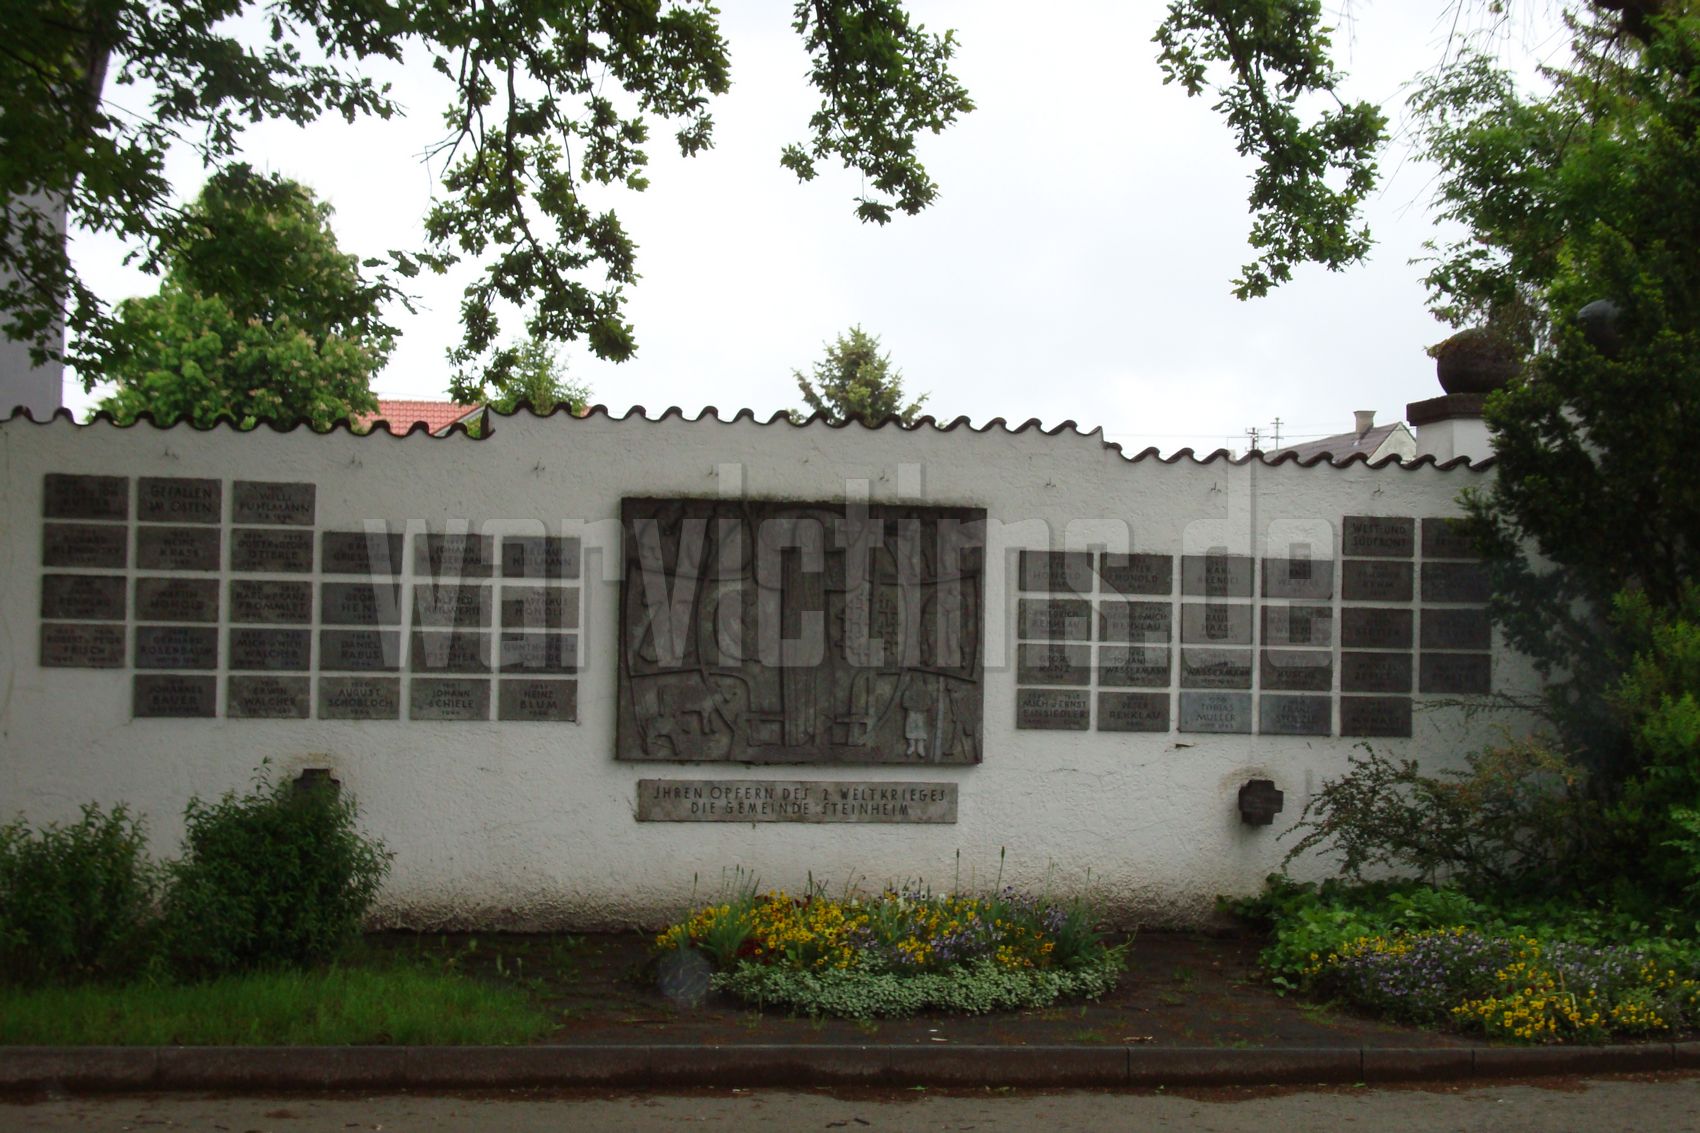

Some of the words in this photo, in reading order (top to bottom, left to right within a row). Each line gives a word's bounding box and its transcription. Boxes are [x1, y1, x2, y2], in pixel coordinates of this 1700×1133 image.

[710, 786, 774, 801] OPFERN
[782, 787, 809, 801] DES
[840, 787, 946, 802] WELTKRIEGES
[691, 801, 716, 815] DIE
[725, 801, 809, 816] GEMEINDE
[821, 801, 909, 816] STEINHEIM
